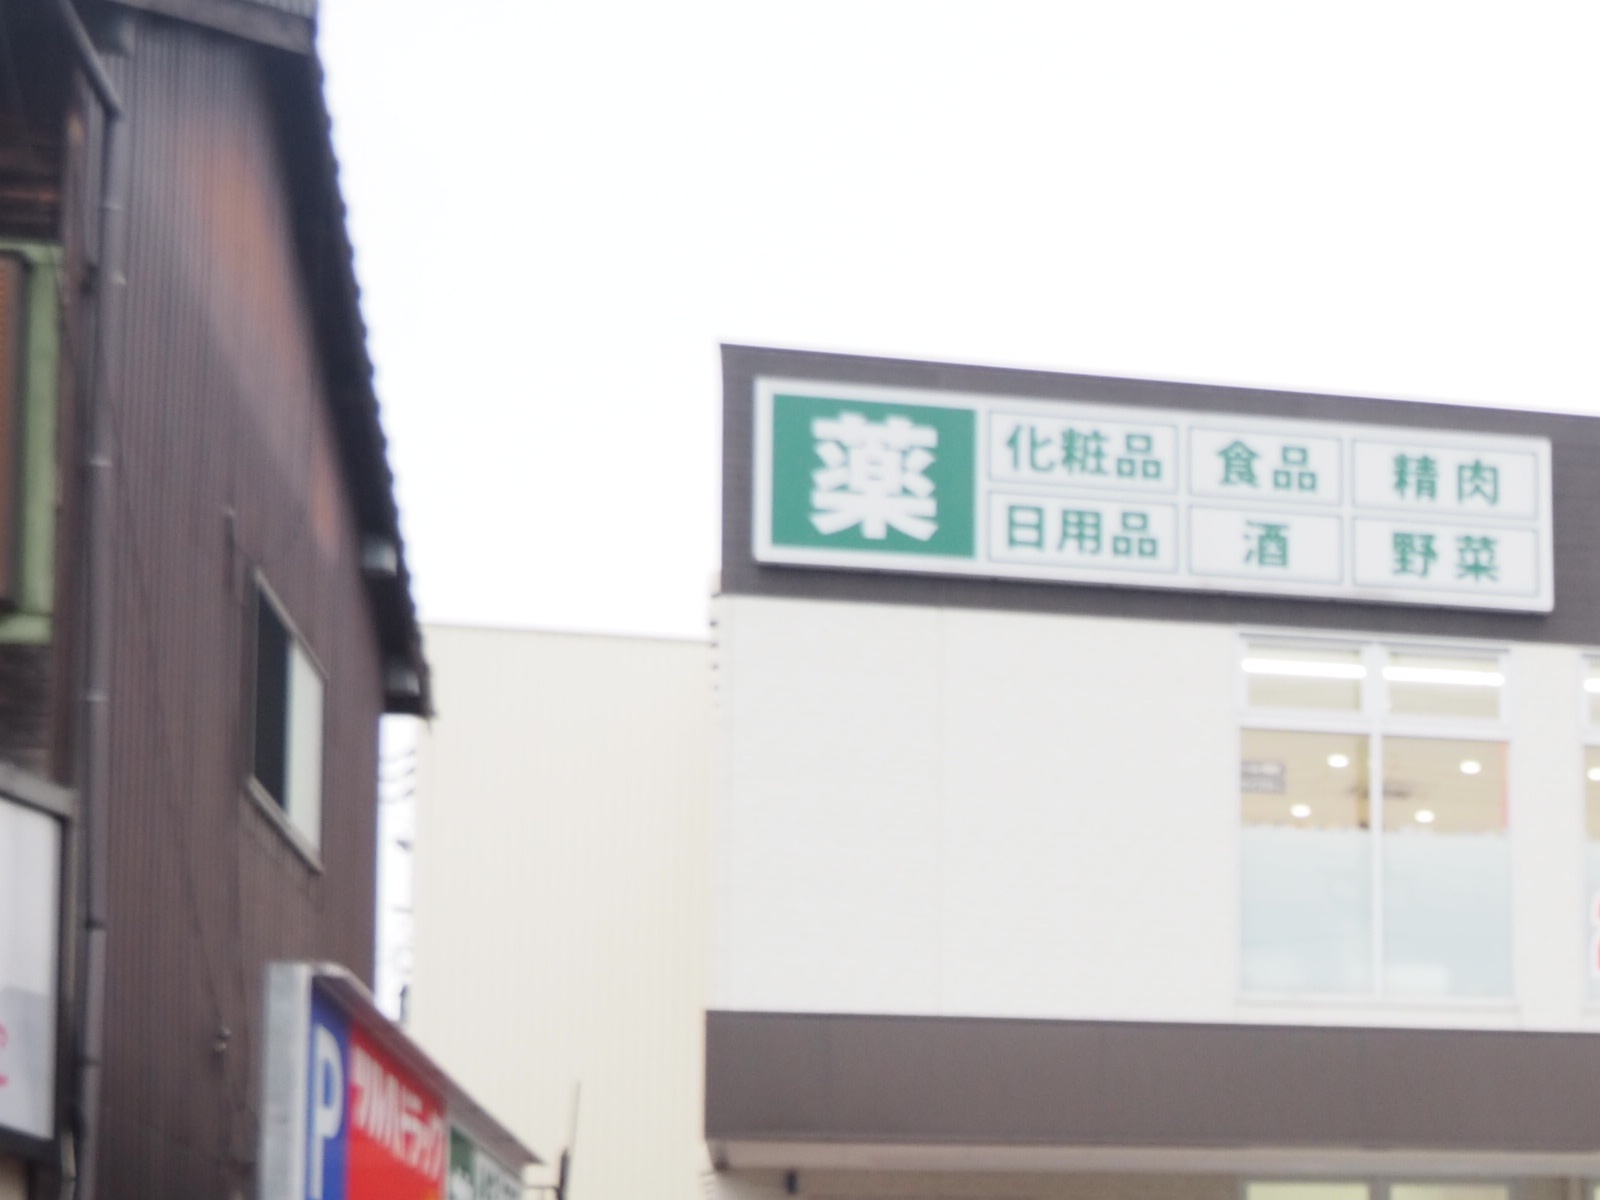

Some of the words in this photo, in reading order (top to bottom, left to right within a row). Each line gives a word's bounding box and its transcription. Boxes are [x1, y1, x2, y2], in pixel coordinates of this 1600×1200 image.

[810, 411, 940, 543] 薬
[1005, 423, 1163, 481] 化粧品
[1217, 439, 1318, 493] 食品
[1392, 453, 1500, 506] 精肉
[1006, 504, 1160, 559] 日用品
[1243, 520, 1290, 568] 酒
[1392, 532, 1500, 583] 野菜
